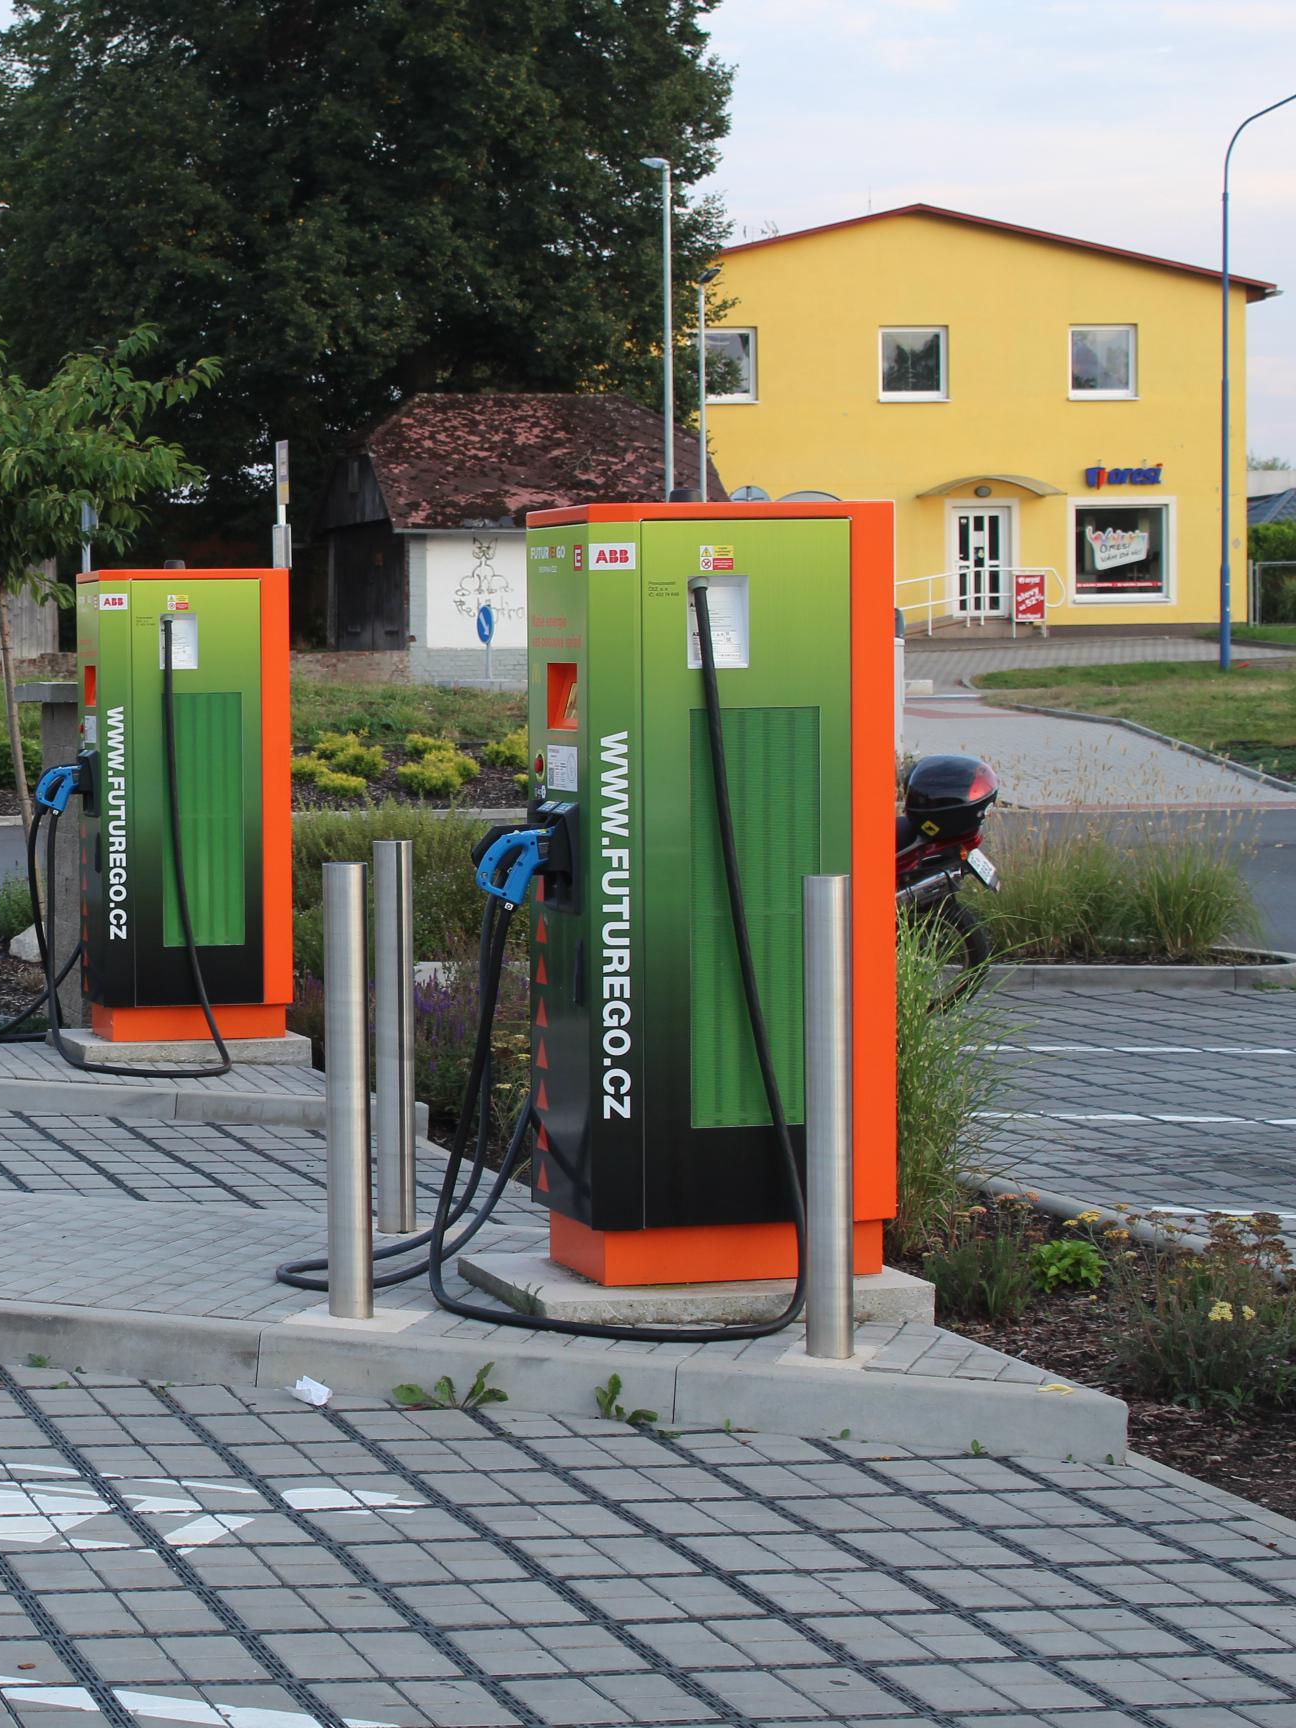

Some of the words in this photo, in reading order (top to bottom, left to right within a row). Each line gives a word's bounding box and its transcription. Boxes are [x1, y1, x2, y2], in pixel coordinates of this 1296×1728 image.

[1107, 463, 1163, 485] oresi
[595, 549, 630, 564] ABB
[104, 597, 125, 606] ABB
[107, 706, 127, 940] WWW.FUTUREGO.CZ
[600, 731, 631, 1119] WWW.FUTUREGO.CZ
